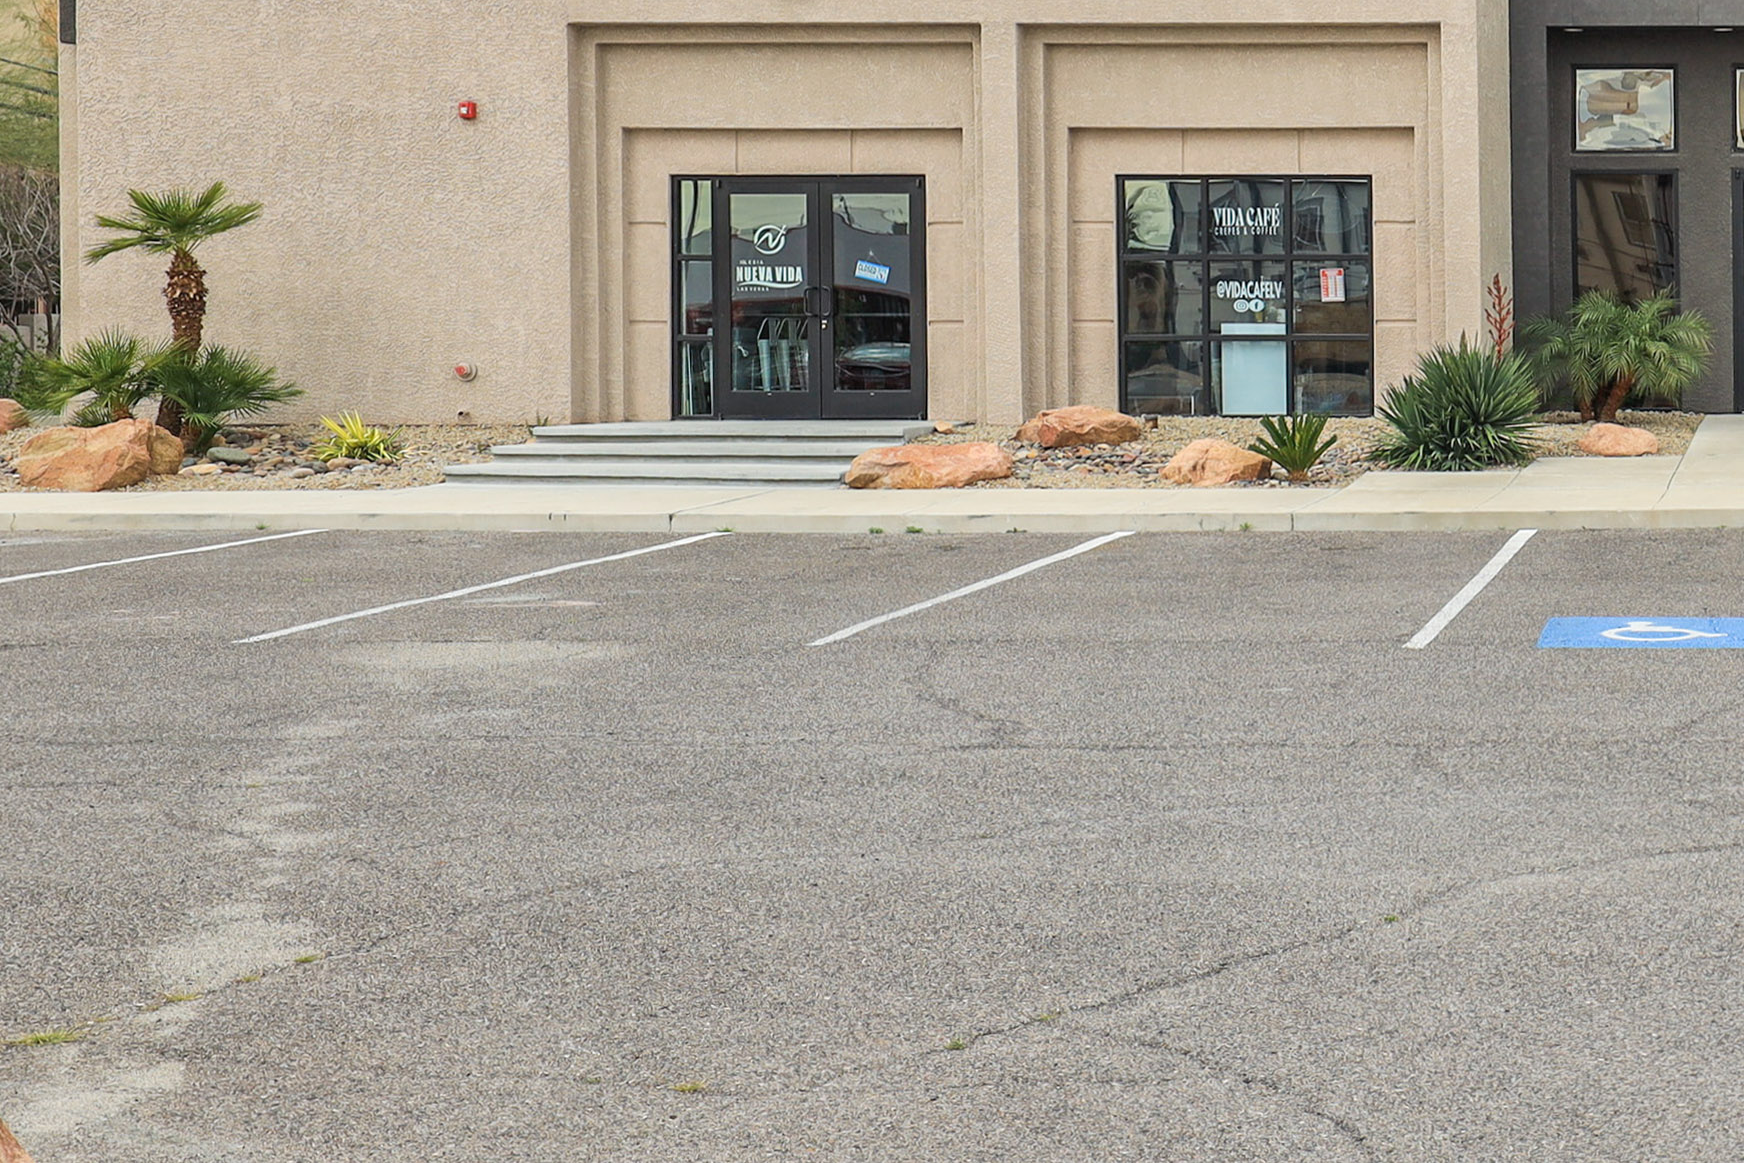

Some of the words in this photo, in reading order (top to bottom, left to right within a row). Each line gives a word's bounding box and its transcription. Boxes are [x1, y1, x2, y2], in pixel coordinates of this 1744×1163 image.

[1212, 206, 1245, 227] VIDA
[1245, 202, 1281, 227] CAFÉ
[735, 266, 774, 282] NUEVA
[774, 266, 803, 283] VIDA
[1216, 280, 1283, 299] @VIDACAFELV
